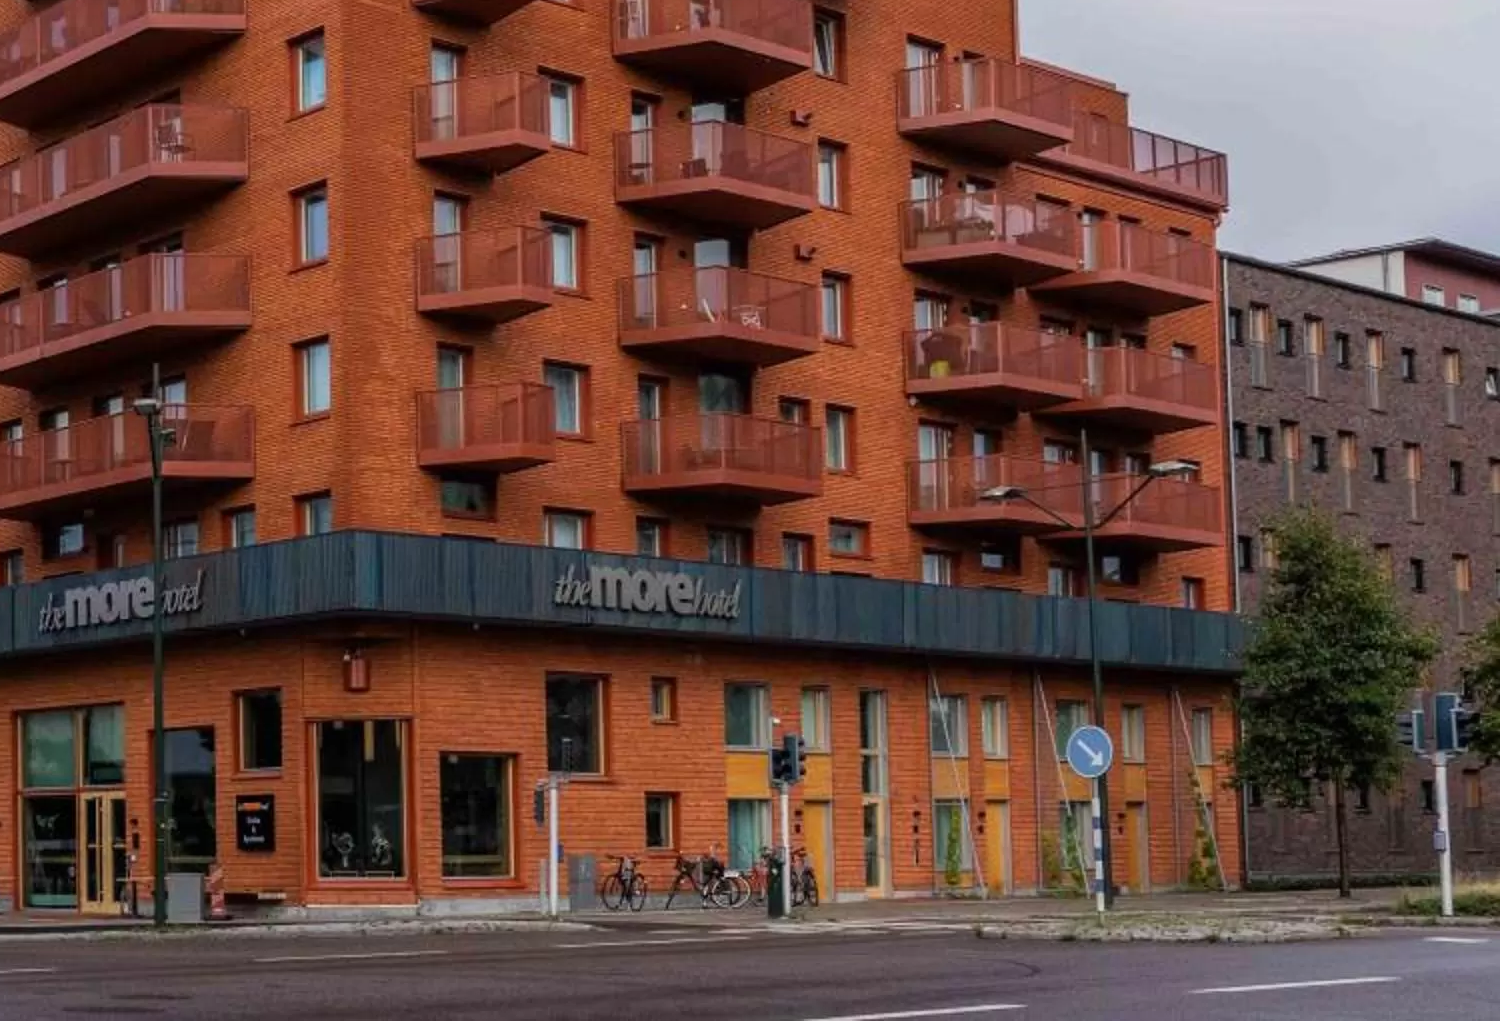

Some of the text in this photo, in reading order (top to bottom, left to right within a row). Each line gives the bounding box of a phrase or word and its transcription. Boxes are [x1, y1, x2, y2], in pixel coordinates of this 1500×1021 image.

[64, 576, 155, 628] more
[555, 563, 741, 617] the more hotel
